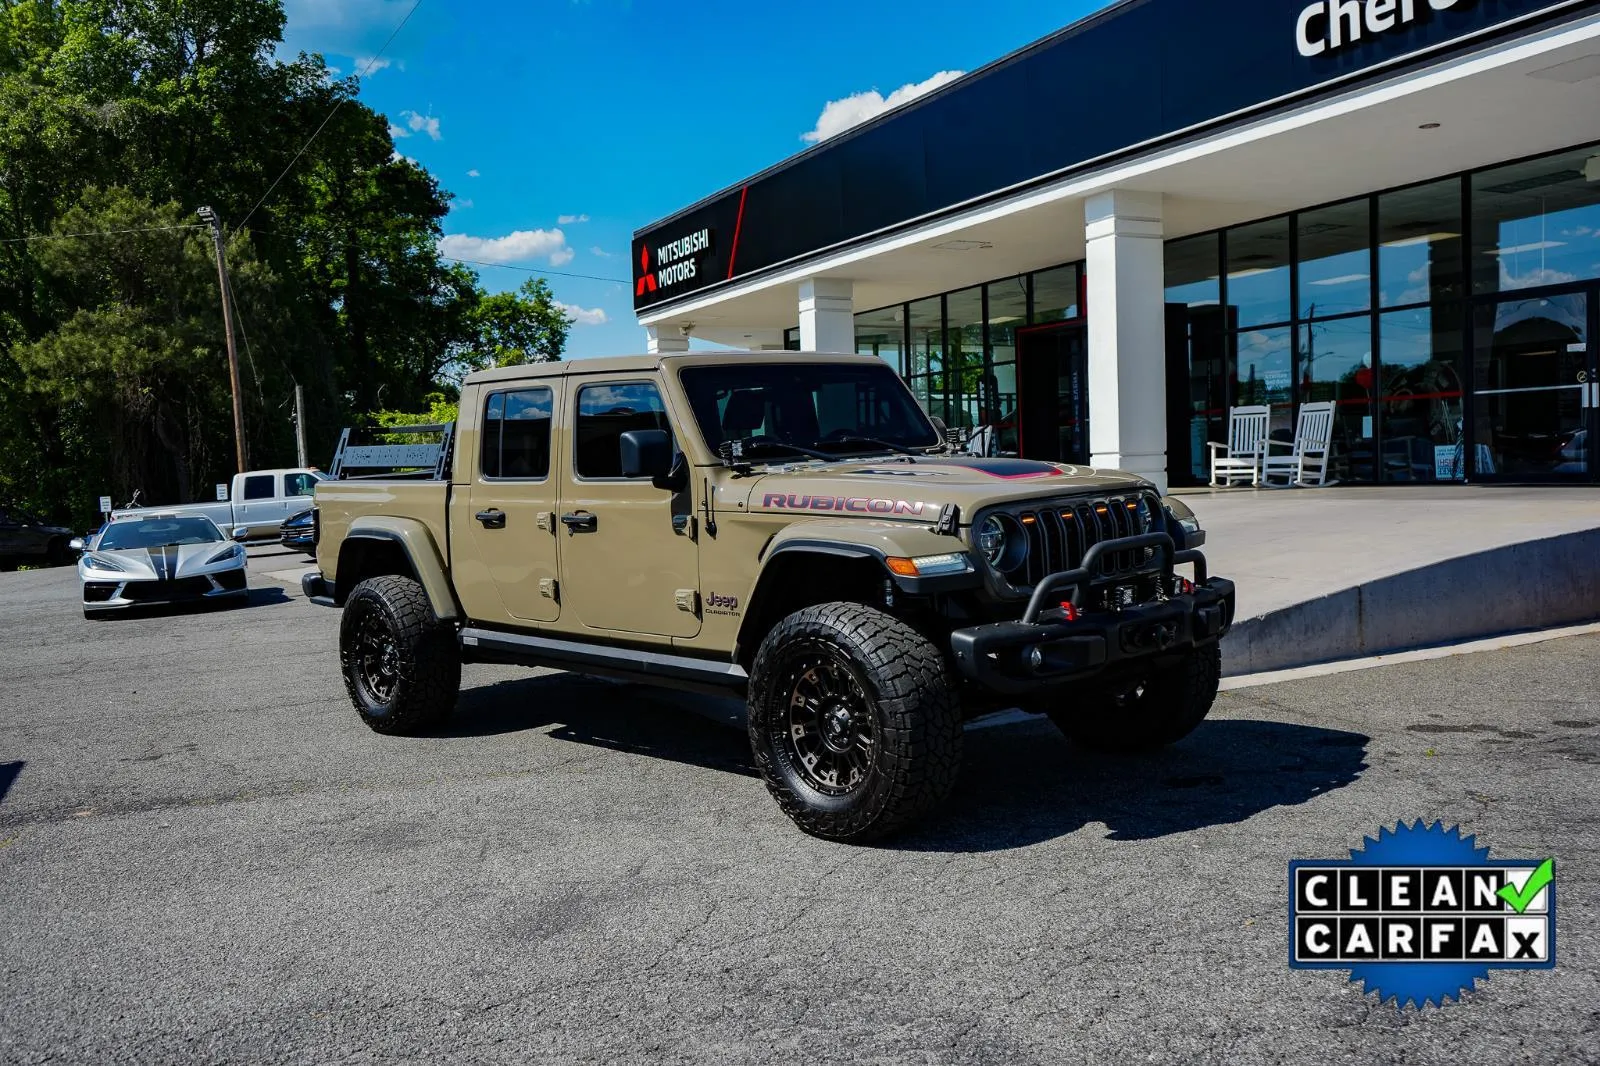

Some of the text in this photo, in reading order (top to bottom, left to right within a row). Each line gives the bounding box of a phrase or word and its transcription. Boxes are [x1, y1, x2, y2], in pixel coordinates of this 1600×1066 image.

[1296, 0, 1459, 57] Che
[657, 228, 709, 266] MITSUBISHI
[658, 257, 696, 288] MOTORS
[762, 493, 924, 515] RUBICON
[705, 591, 738, 611] Jeep
